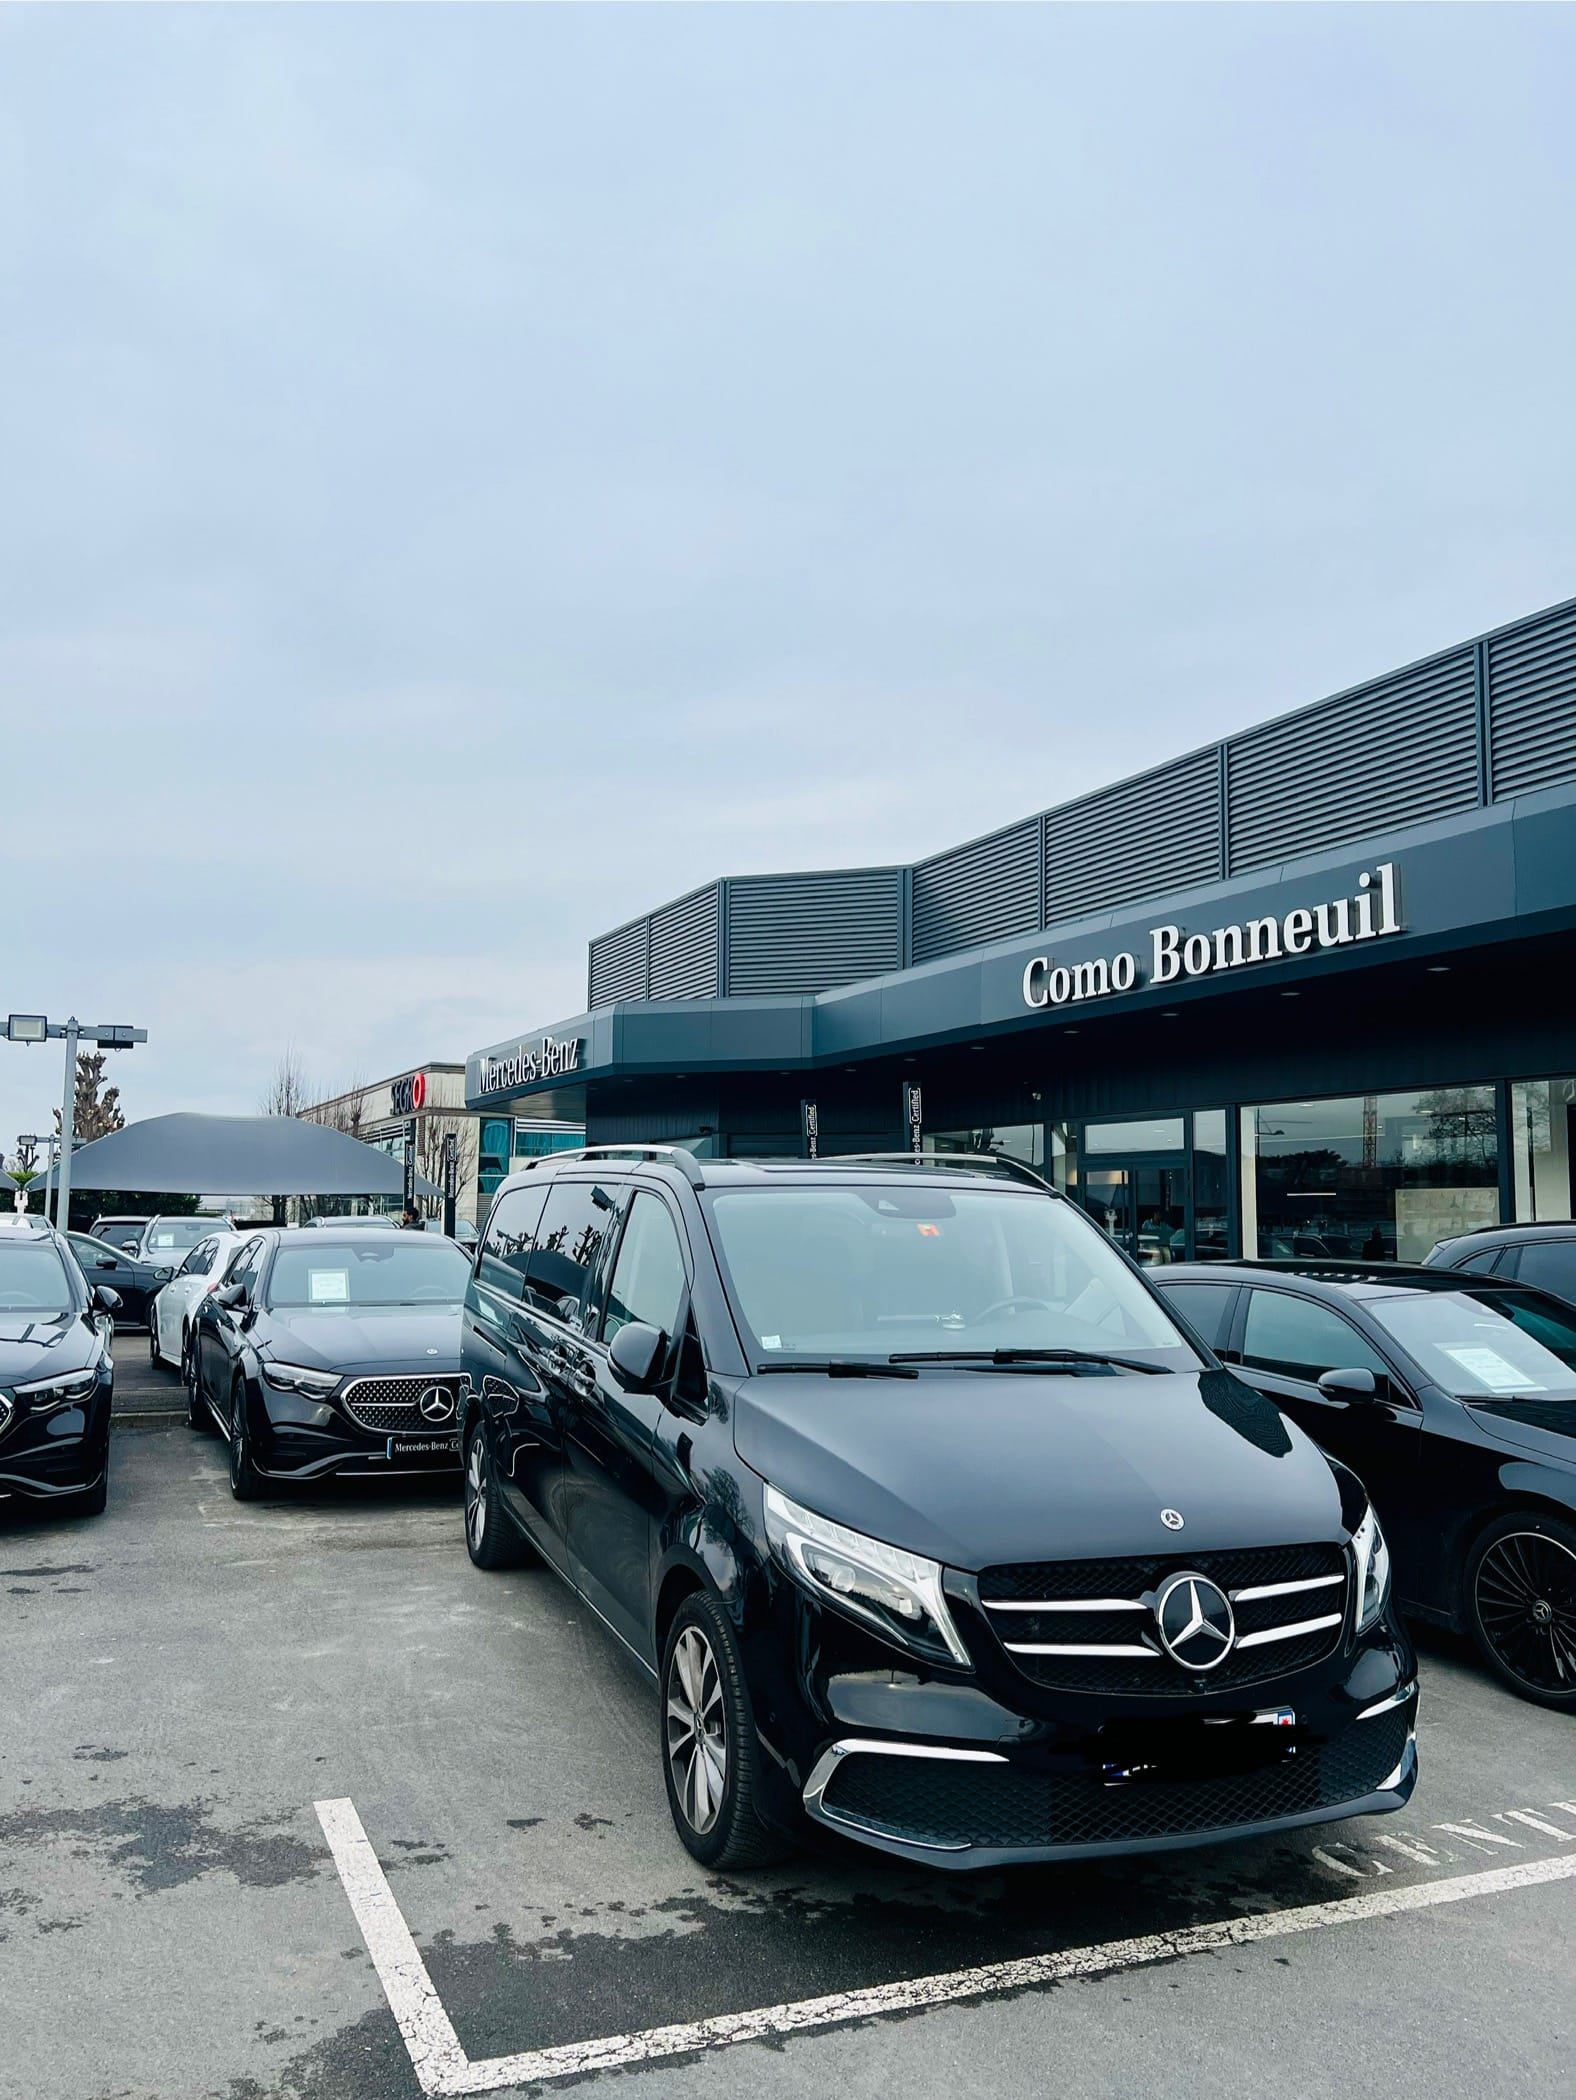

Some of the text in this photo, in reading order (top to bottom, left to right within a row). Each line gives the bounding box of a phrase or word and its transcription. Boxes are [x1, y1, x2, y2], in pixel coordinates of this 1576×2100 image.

[1022, 862, 1402, 1009] Como Bonneuil
[478, 1036, 579, 1094] Mercedes-Benz
[808, 1106, 816, 1135] Certified
[911, 1090, 920, 1122] Certified
[395, 1441, 448, 1452] Mercedes-Benz
